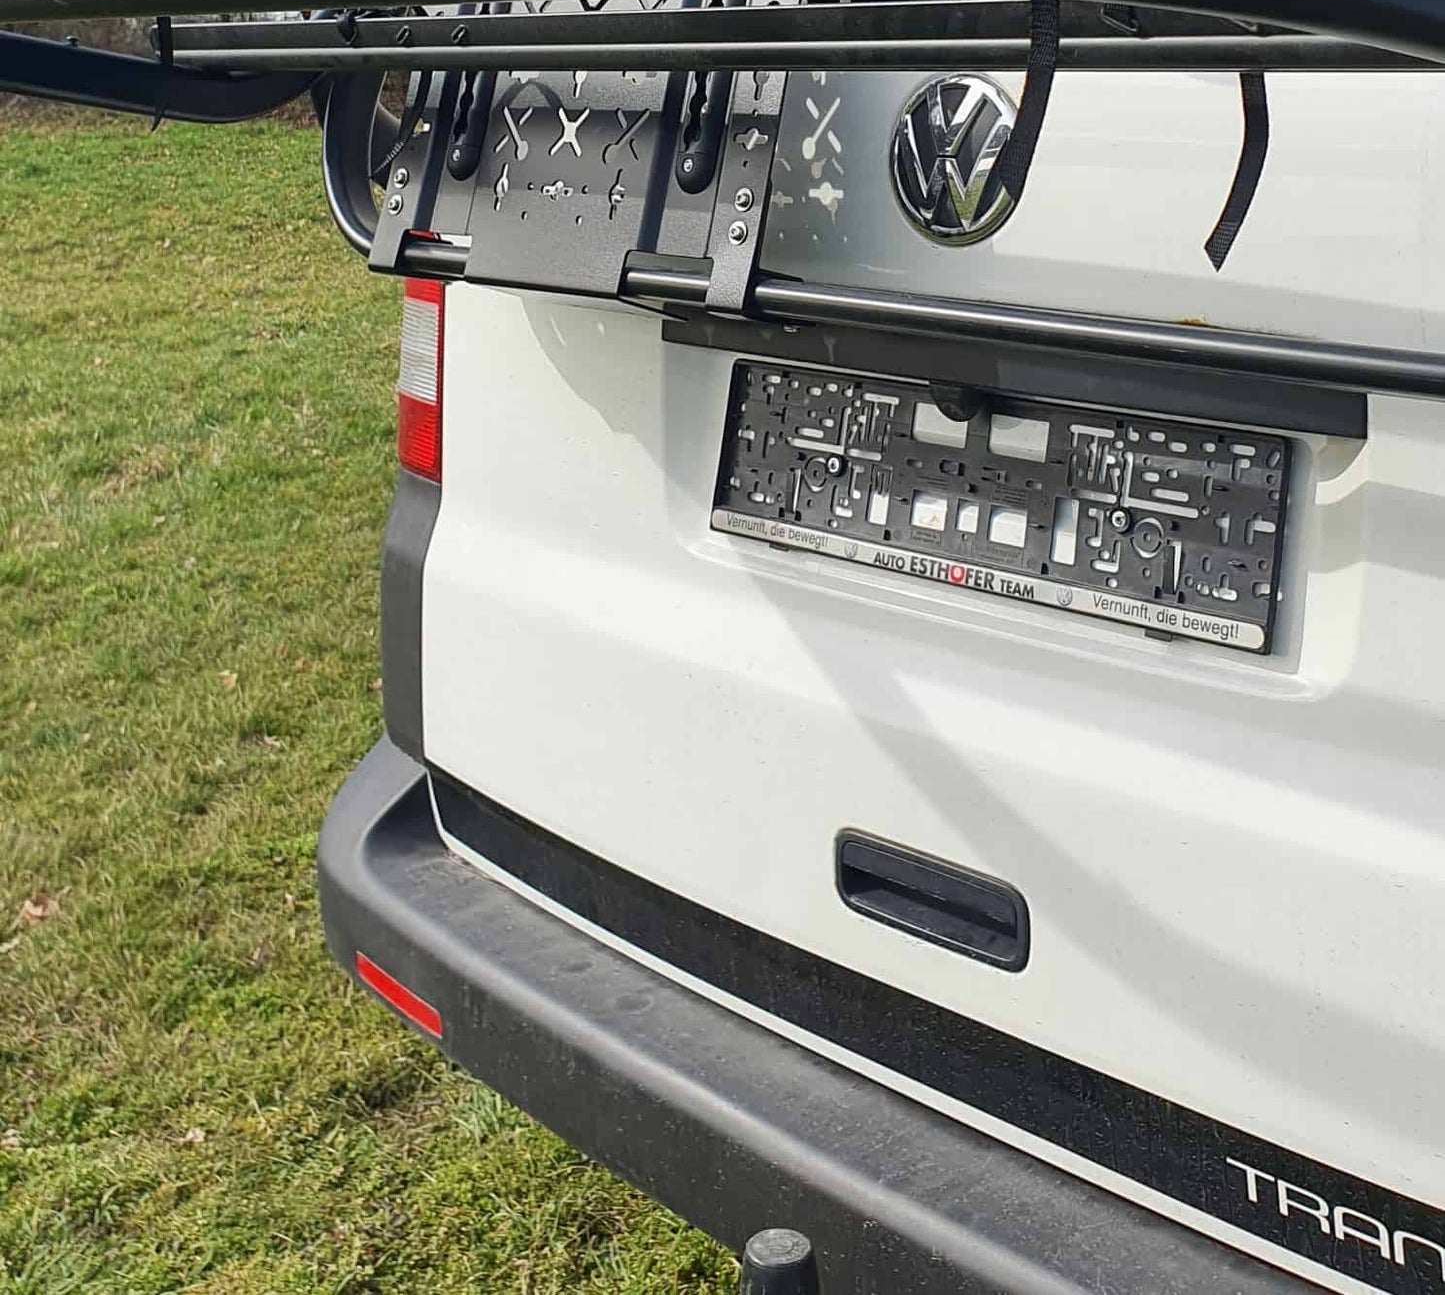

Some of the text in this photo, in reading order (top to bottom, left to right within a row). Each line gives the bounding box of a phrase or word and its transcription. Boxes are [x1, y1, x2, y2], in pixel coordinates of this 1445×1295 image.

[892, 75, 1016, 245] VW
[727, 513, 829, 549] Vernunft, die bewegt!
[873, 551, 1034, 599] AUTO ESTHOFER TEAM
[1093, 593, 1239, 641] Vernunft, die bewegt!
[1225, 1156, 1445, 1283] TRAN
